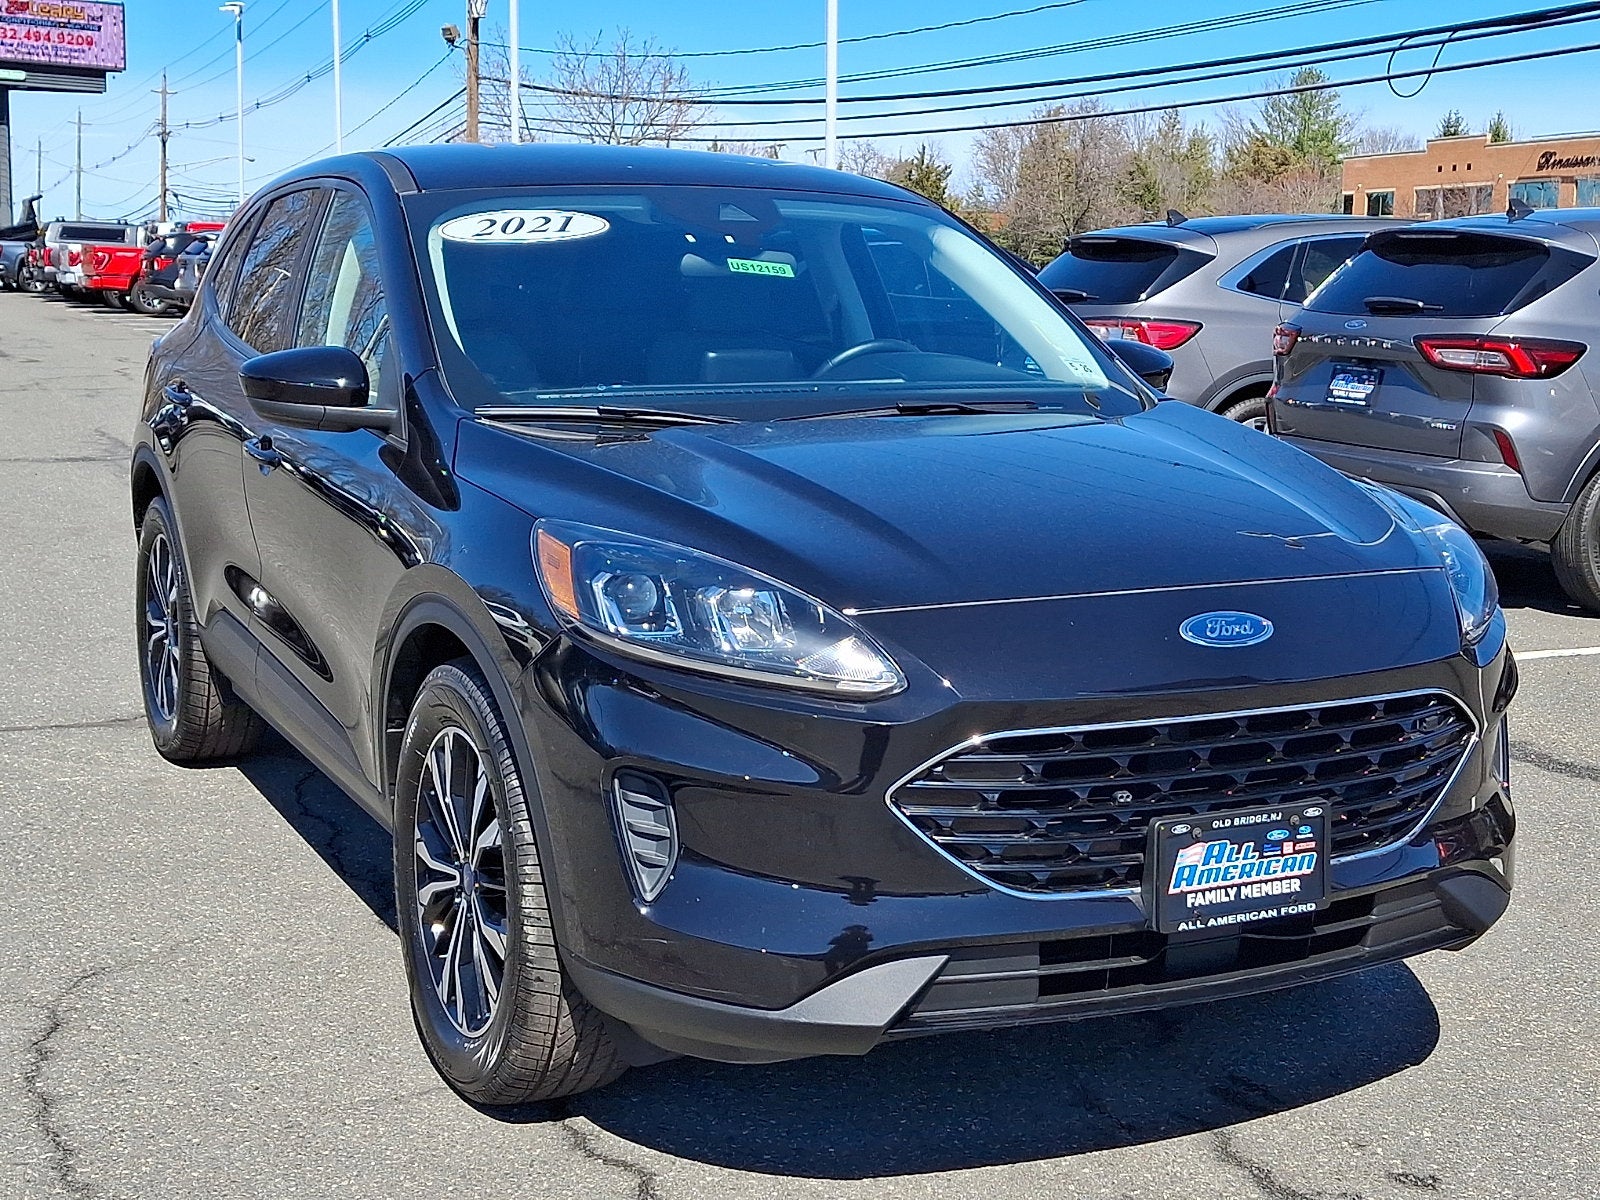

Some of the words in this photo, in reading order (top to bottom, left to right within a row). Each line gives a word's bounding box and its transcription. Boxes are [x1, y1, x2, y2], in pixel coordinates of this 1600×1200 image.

[472, 215, 574, 238] 2021
[730, 262, 787, 275] US12159
[1206, 617, 1254, 638] Ford
[1212, 819, 1232, 829] OLD
[1202, 840, 1259, 866] ALL
[1173, 853, 1316, 889] AMERICAN
[1186, 887, 1238, 908] FAMILY
[1240, 878, 1301, 899] MEMBER
[1178, 920, 1206, 932] ALL
[1207, 908, 1278, 928] AMERICAN
[1280, 902, 1317, 917] FORD
